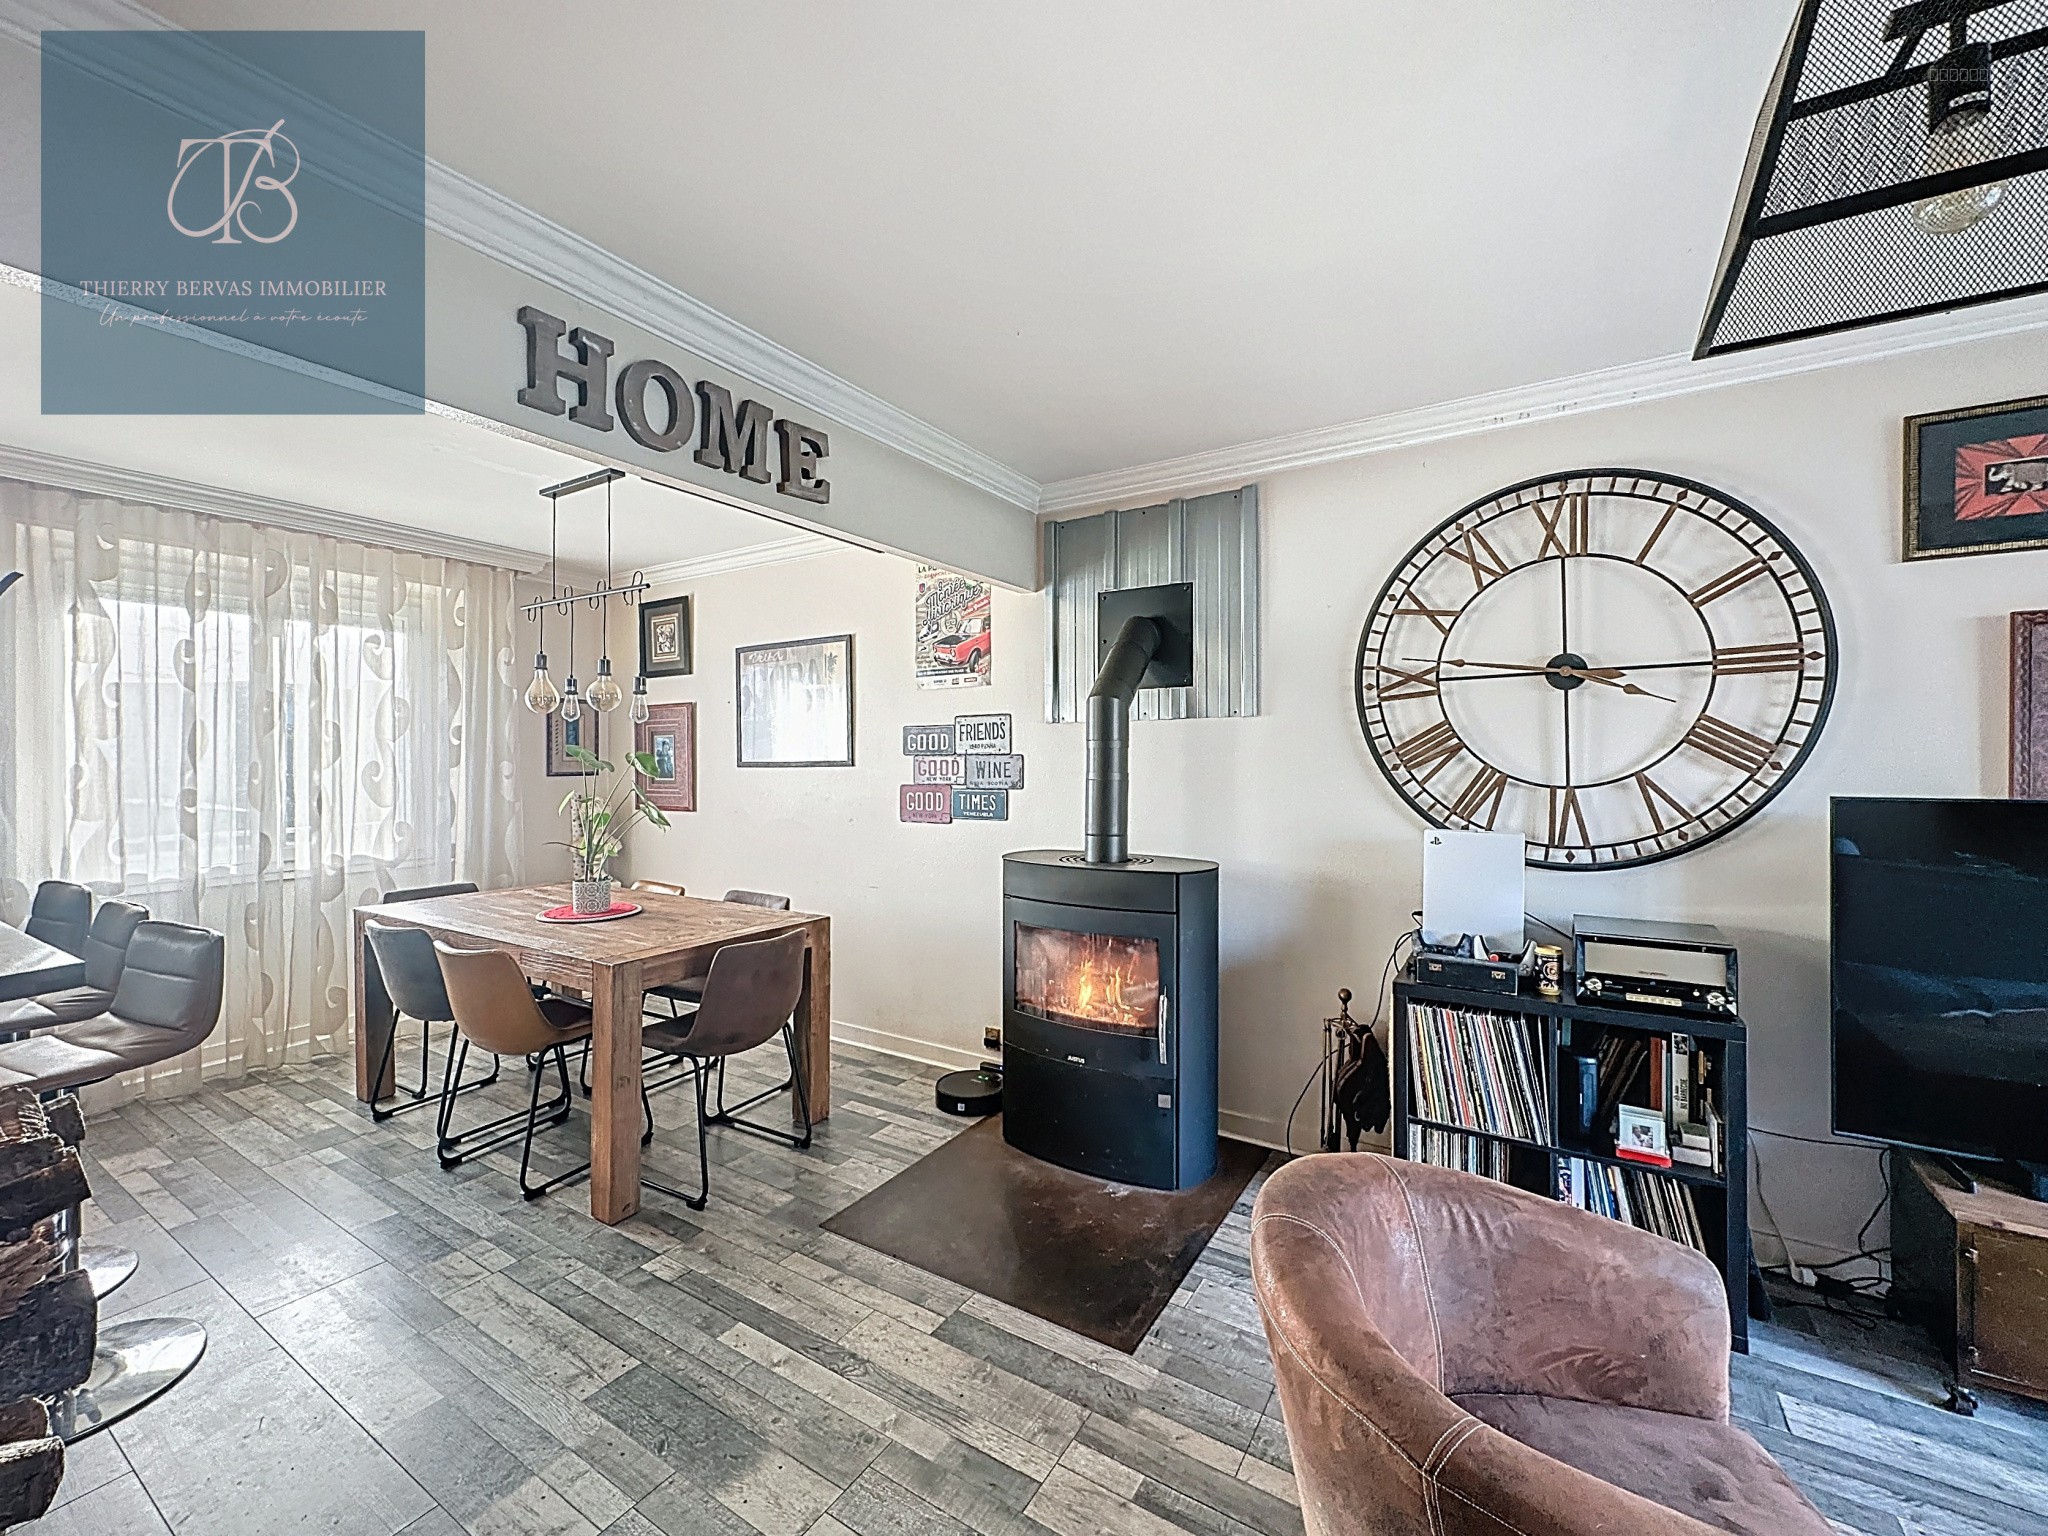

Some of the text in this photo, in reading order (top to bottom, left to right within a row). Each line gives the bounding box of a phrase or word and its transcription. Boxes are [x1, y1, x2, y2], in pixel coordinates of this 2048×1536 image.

[517, 305, 830, 504] HOME
[907, 733, 949, 751] GOOD
[959, 722, 1006, 742] FRIENDS
[917, 759, 960, 777] GOOD
[975, 760, 1012, 780] WINE
[906, 791, 944, 812] GOOD
[958, 793, 996, 811] TIMES
